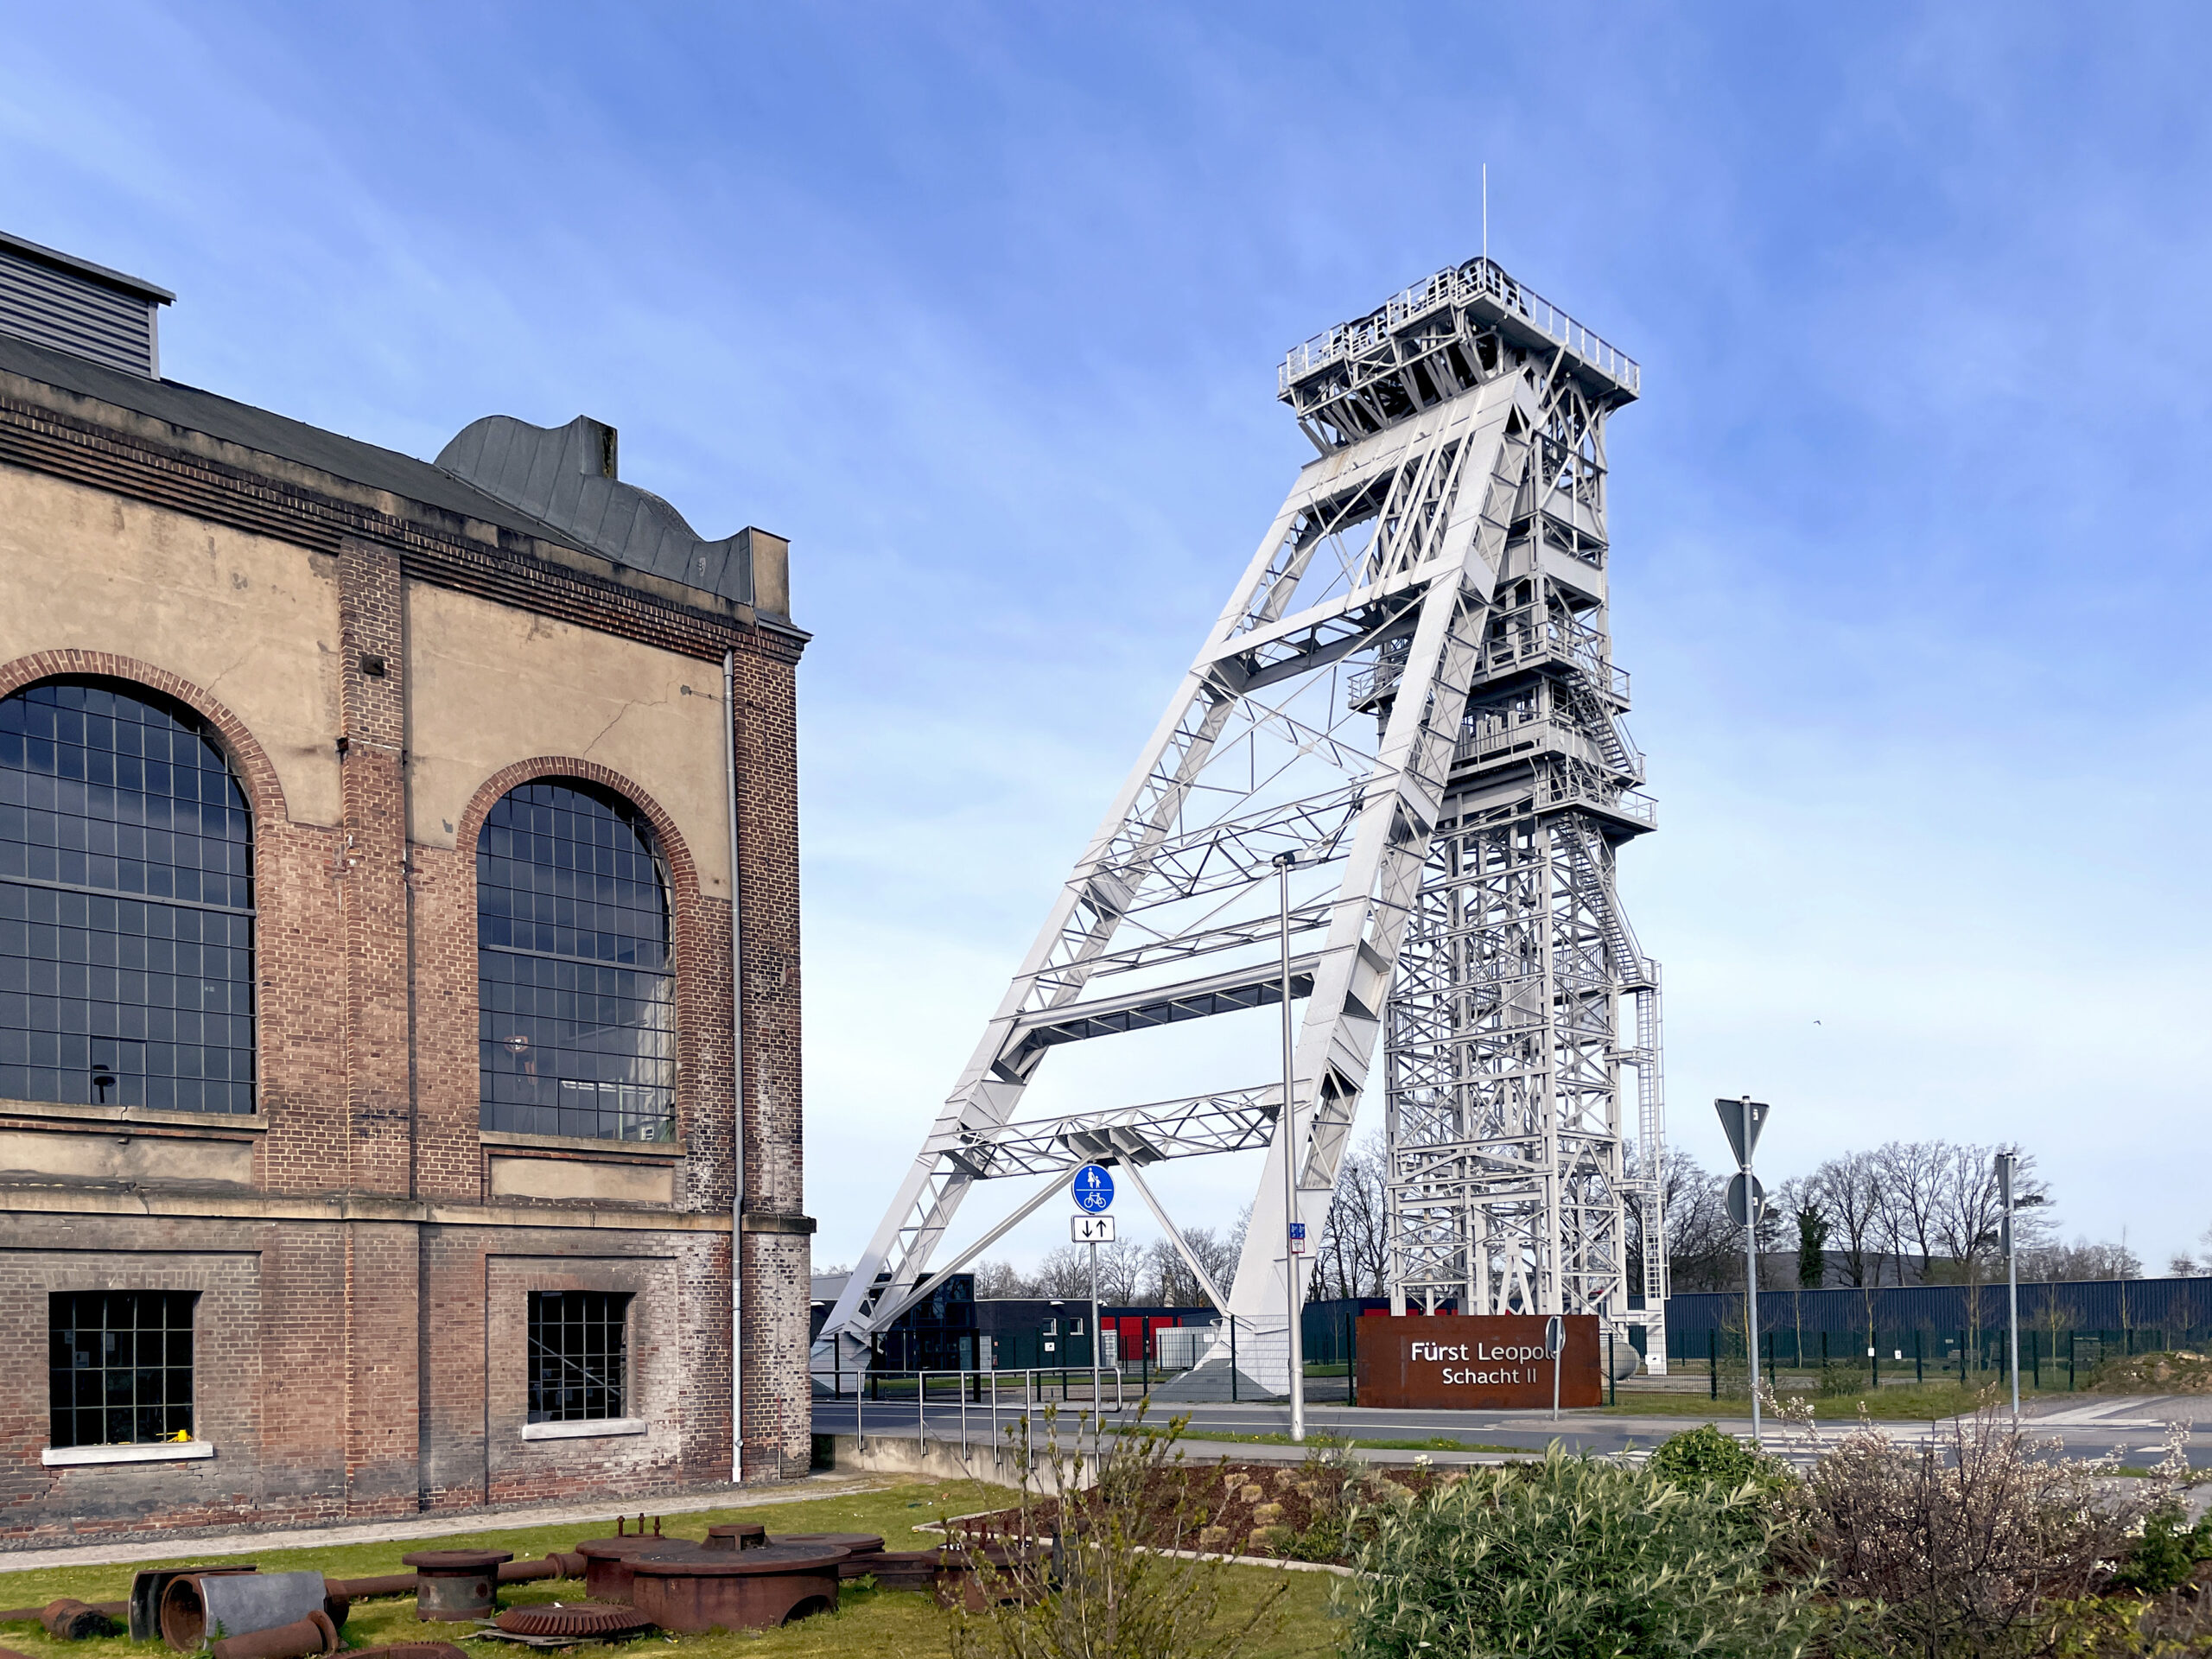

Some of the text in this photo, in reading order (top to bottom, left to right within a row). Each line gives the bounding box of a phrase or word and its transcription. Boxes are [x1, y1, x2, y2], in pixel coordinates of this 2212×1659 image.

[1411, 1341, 1470, 1361] Fürst
[1442, 1368, 1536, 1384] Schacht II
